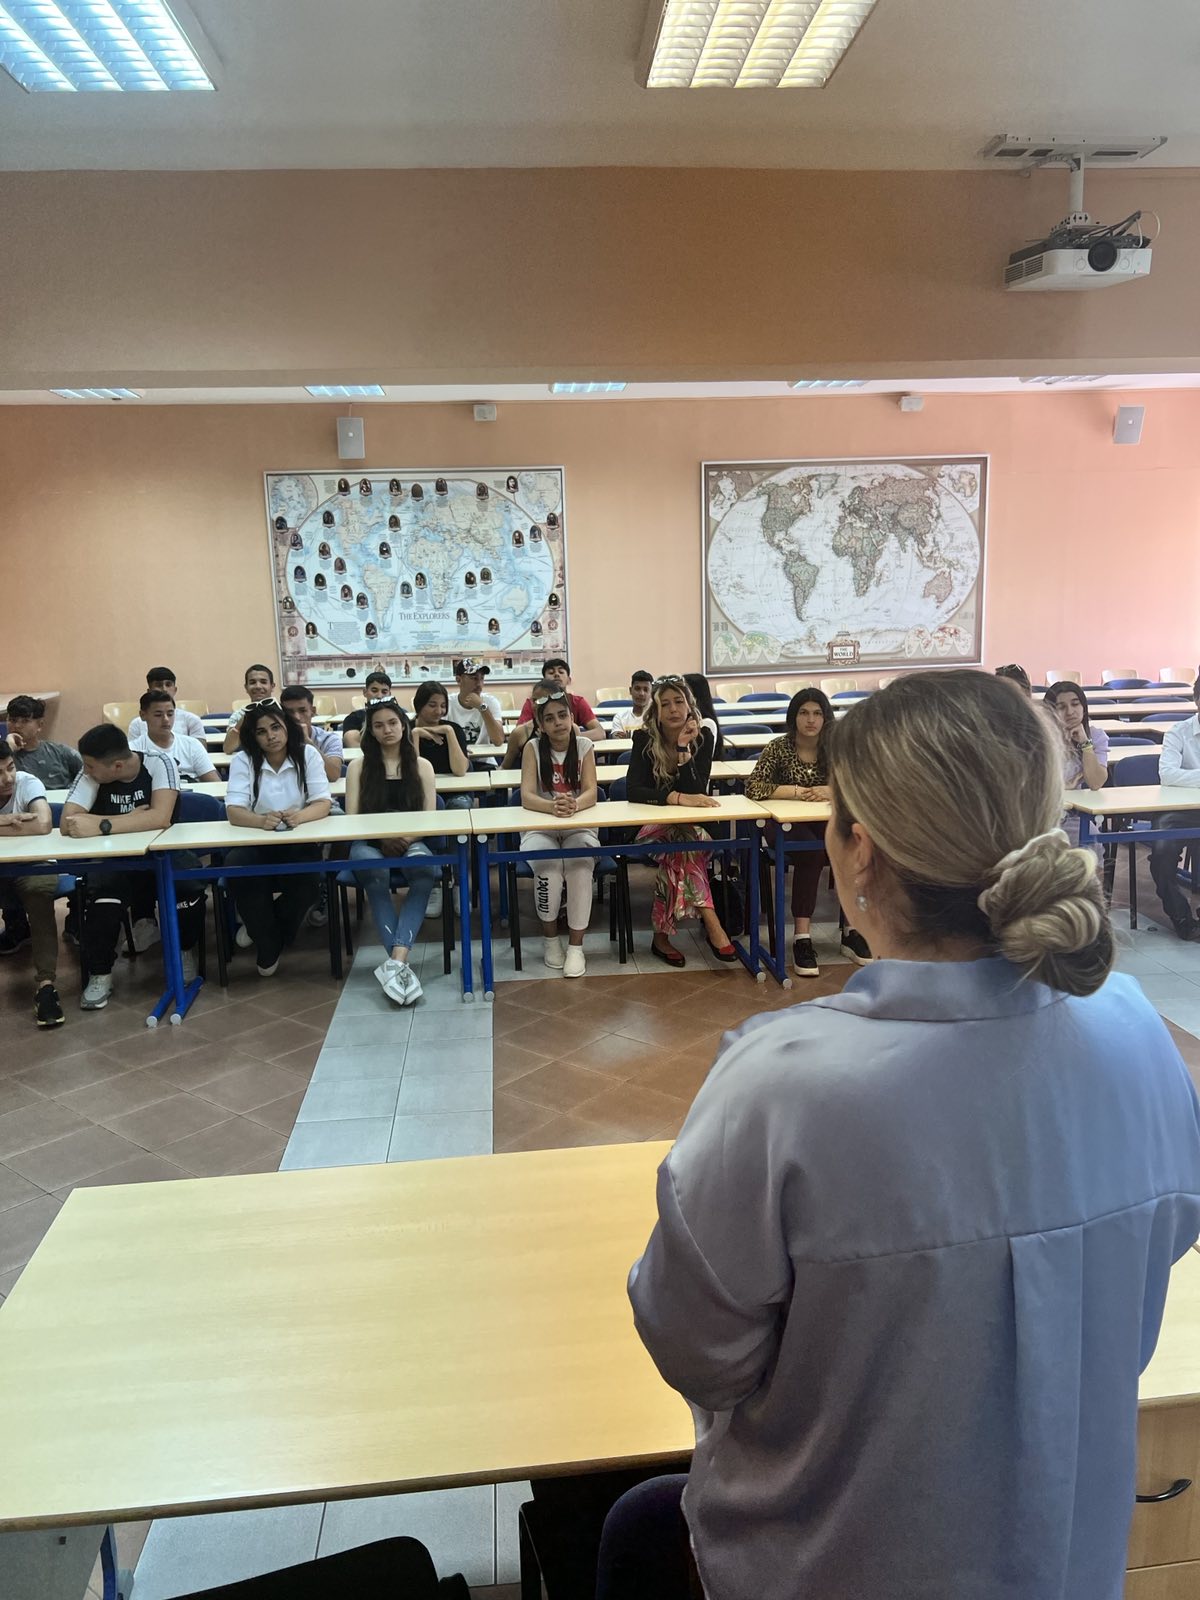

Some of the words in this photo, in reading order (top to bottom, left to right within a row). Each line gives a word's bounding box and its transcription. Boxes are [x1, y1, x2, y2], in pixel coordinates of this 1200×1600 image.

[399, 612, 412, 620] THE
[413, 612, 450, 620] EXPLORERS
[110, 793, 131, 804] NIKE
